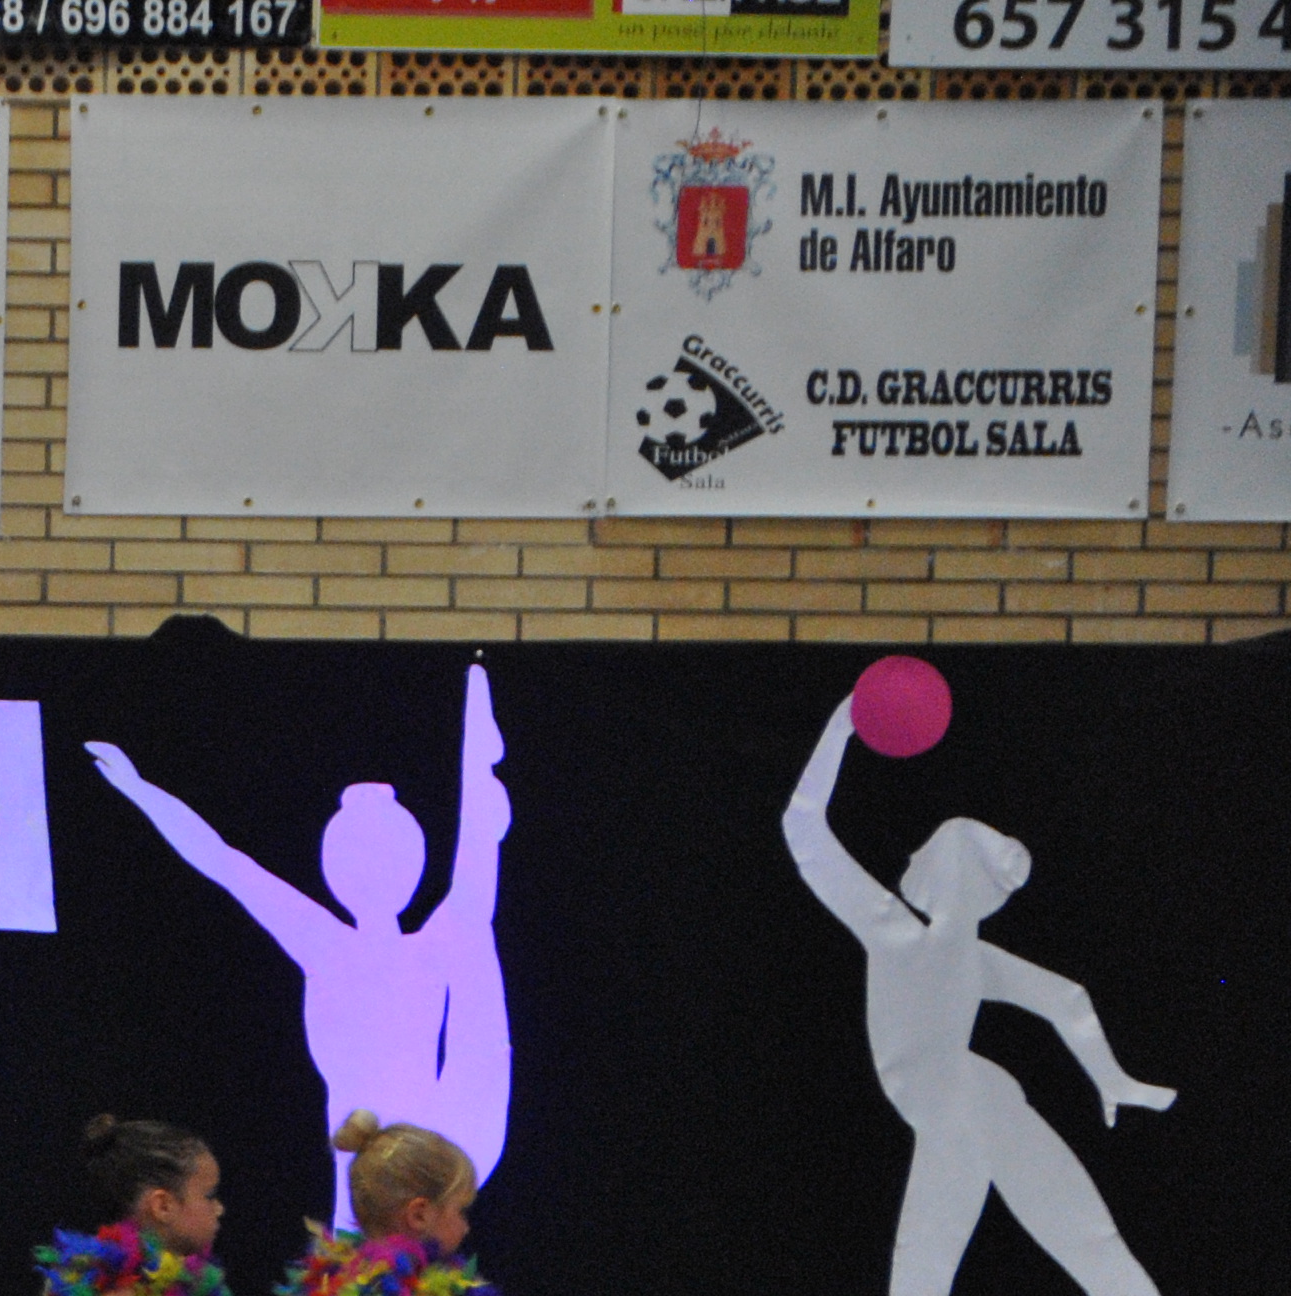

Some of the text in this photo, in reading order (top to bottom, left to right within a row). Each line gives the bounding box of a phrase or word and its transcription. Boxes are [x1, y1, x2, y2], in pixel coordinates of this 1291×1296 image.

[61, 0, 130, 36] 696
[143, 0, 213, 37] 884
[228, 0, 296, 37] 167
[953, 0, 1086, 50] 657
[1107, 0, 1238, 51] 315
[800, 171, 1109, 224] M.I. Ayuntamiento
[799, 227, 957, 273] de Alfaro
[682, 334, 786, 435] Graccurris
[806, 368, 1114, 406] C.D. GRACCURRIS
[831, 419, 1084, 457] FUTBOL SALA
